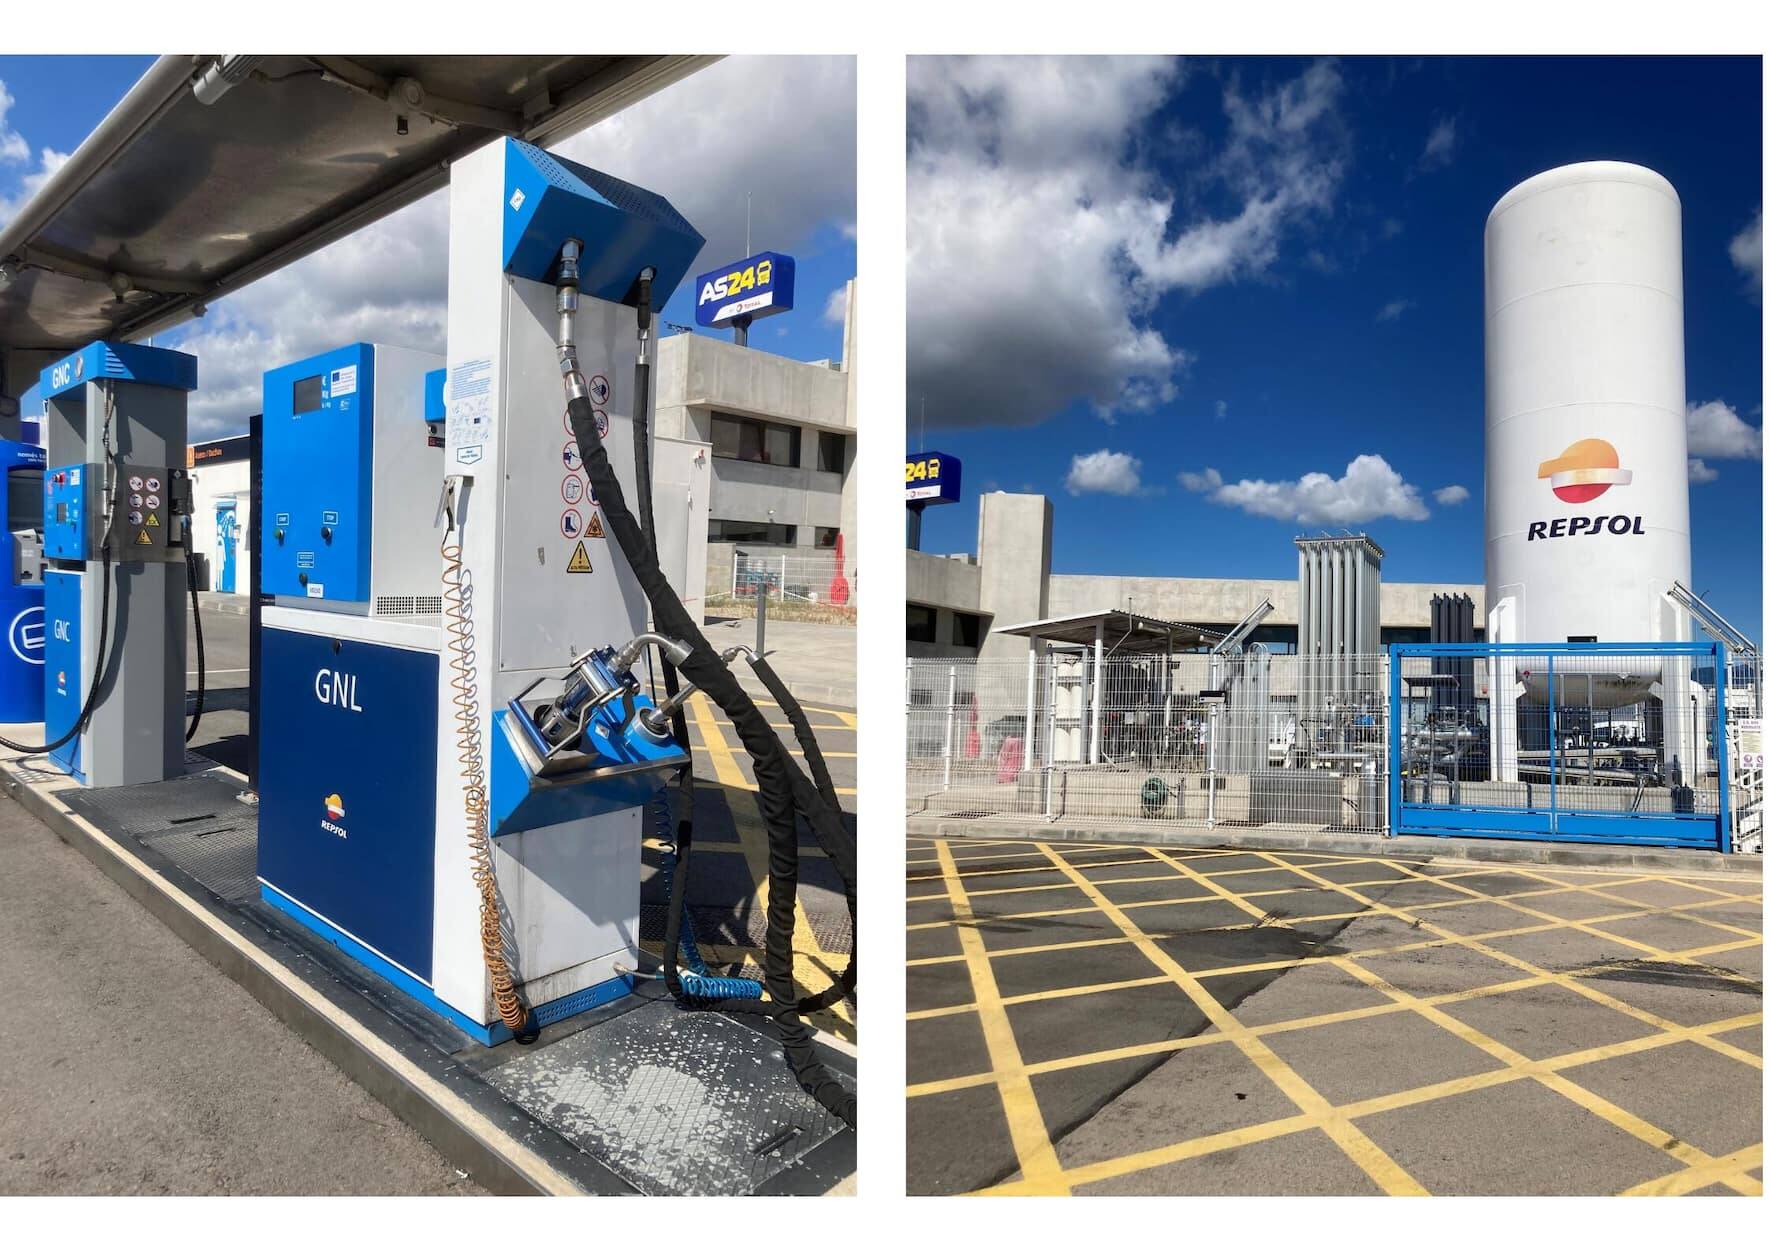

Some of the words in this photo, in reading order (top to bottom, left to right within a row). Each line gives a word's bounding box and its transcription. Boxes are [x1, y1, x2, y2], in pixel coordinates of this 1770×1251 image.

[698, 265, 755, 306] AS24
[52, 362, 71, 389] GNC
[1527, 515, 1646, 541] REPSOL
[54, 619, 71, 643] GNC
[315, 668, 363, 712] GNL
[320, 819, 348, 839] REPSOL
